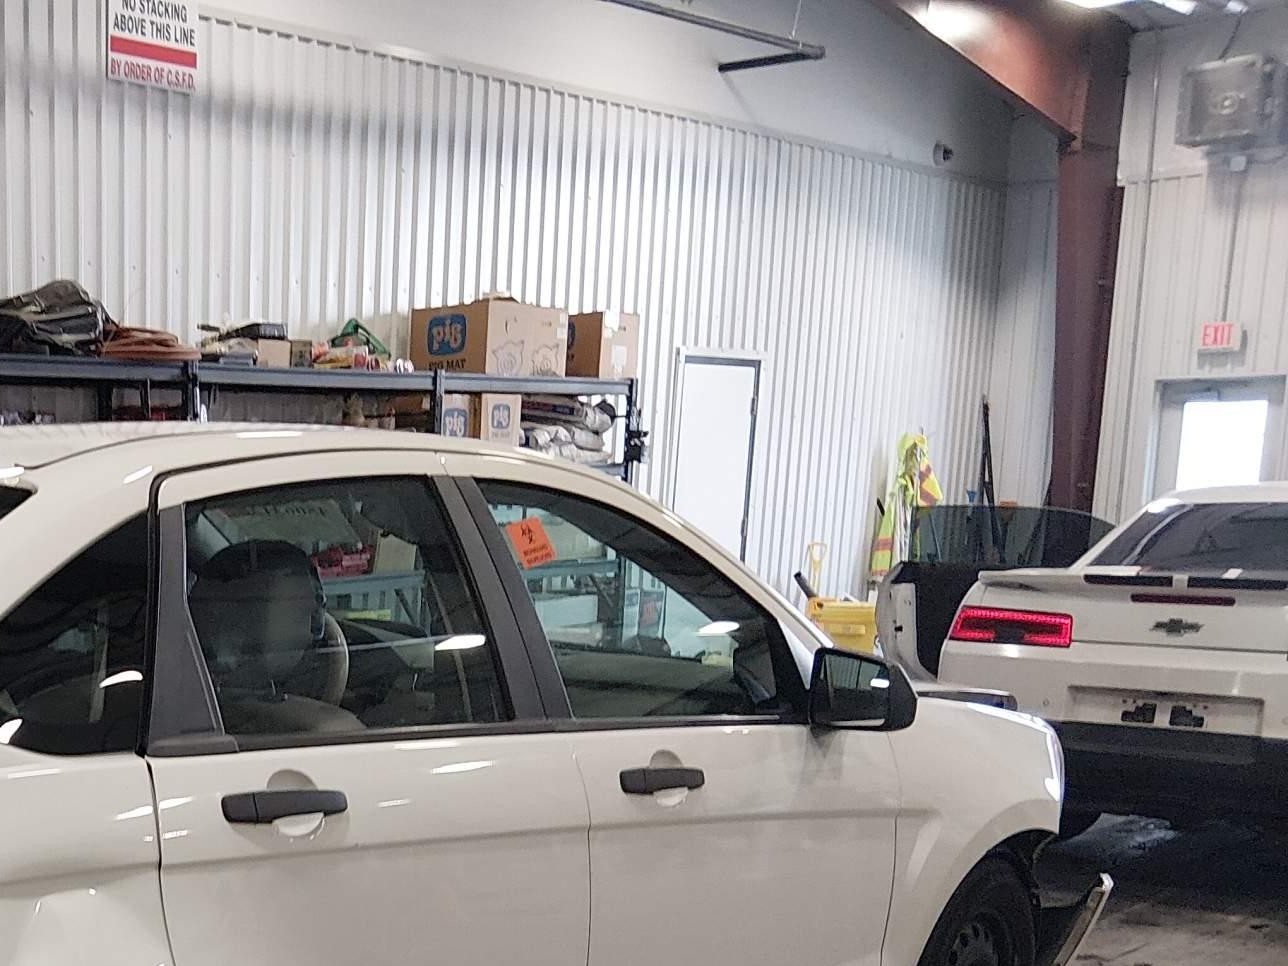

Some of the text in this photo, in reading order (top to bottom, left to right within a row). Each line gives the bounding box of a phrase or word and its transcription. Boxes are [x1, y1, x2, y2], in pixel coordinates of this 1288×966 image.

[122, 0, 187, 22] NO STACKING
[113, 13, 195, 46] ABOVE THIS LINE
[111, 58, 121, 76] BY
[124, 62, 152, 81] ORDER
[154, 67, 164, 83] OF
[1202, 324, 1233, 347] EXIT
[446, 358, 466, 371] MAT
